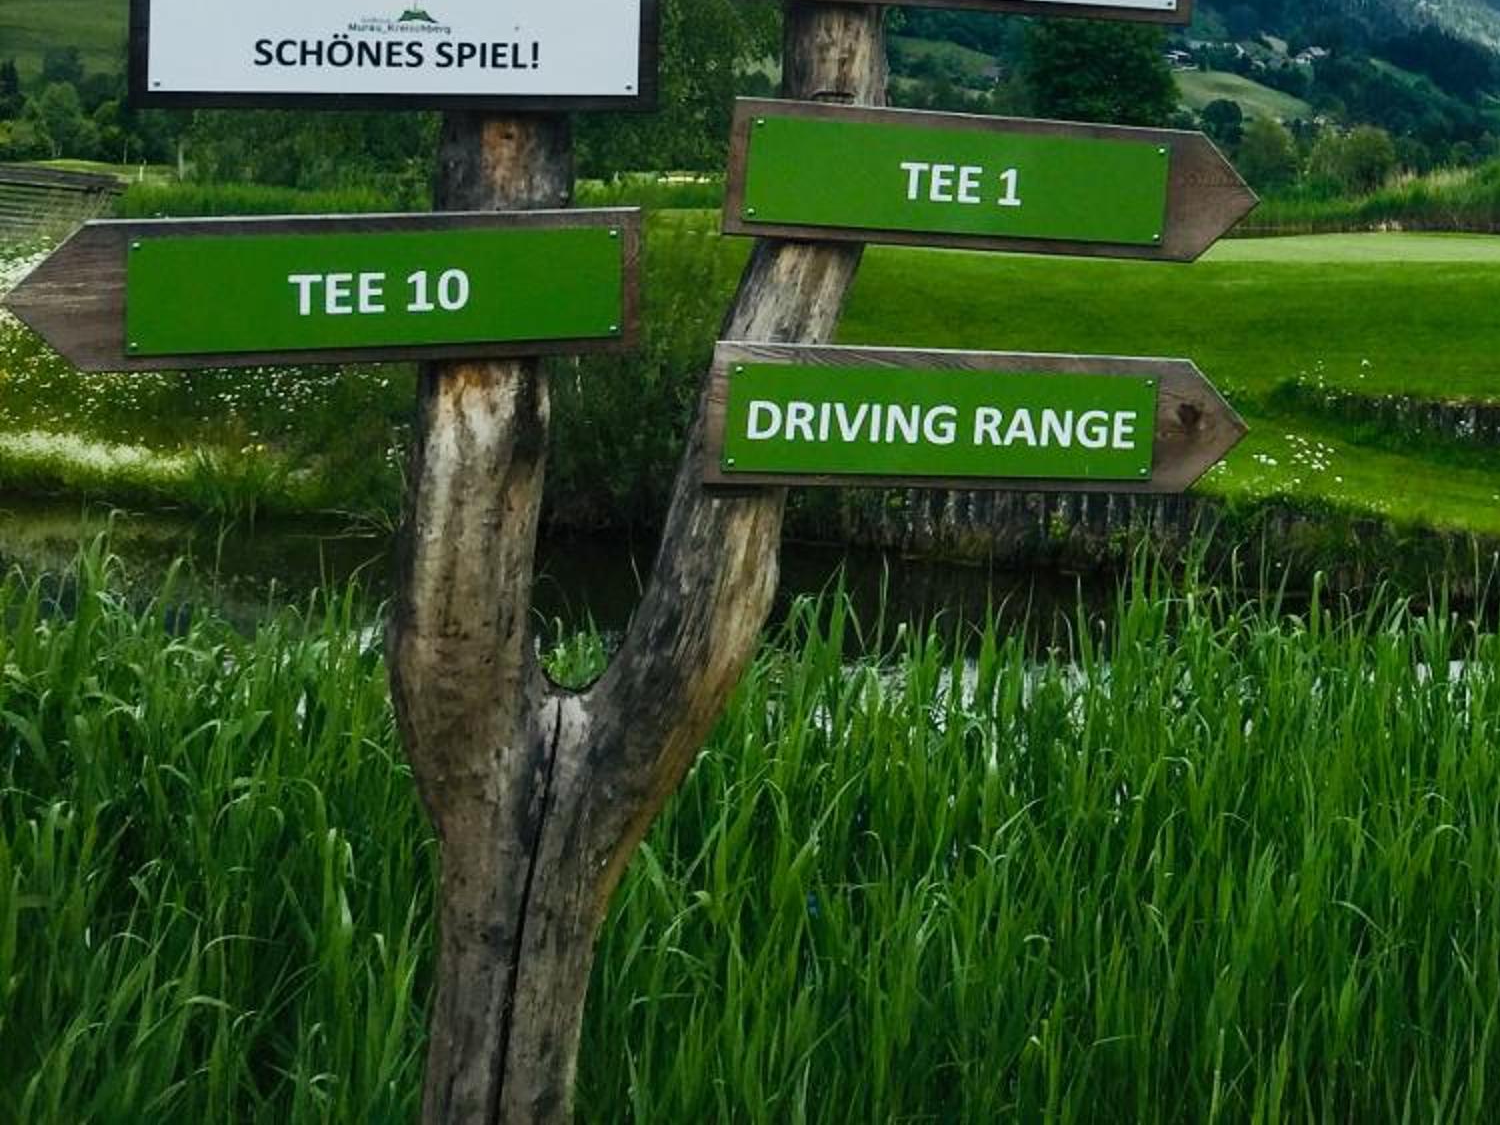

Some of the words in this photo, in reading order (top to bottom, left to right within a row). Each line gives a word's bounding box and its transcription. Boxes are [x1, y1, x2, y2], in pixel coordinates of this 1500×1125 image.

[254, 33, 424, 68] SCHÖNES
[435, 41, 540, 70] SPIEL!
[900, 162, 983, 204] TEE
[997, 168, 1021, 206] 1
[287, 272, 386, 316] TEE
[406, 268, 470, 312] 10
[746, 400, 957, 445] DRIVING
[973, 406, 1137, 449] RANGE
